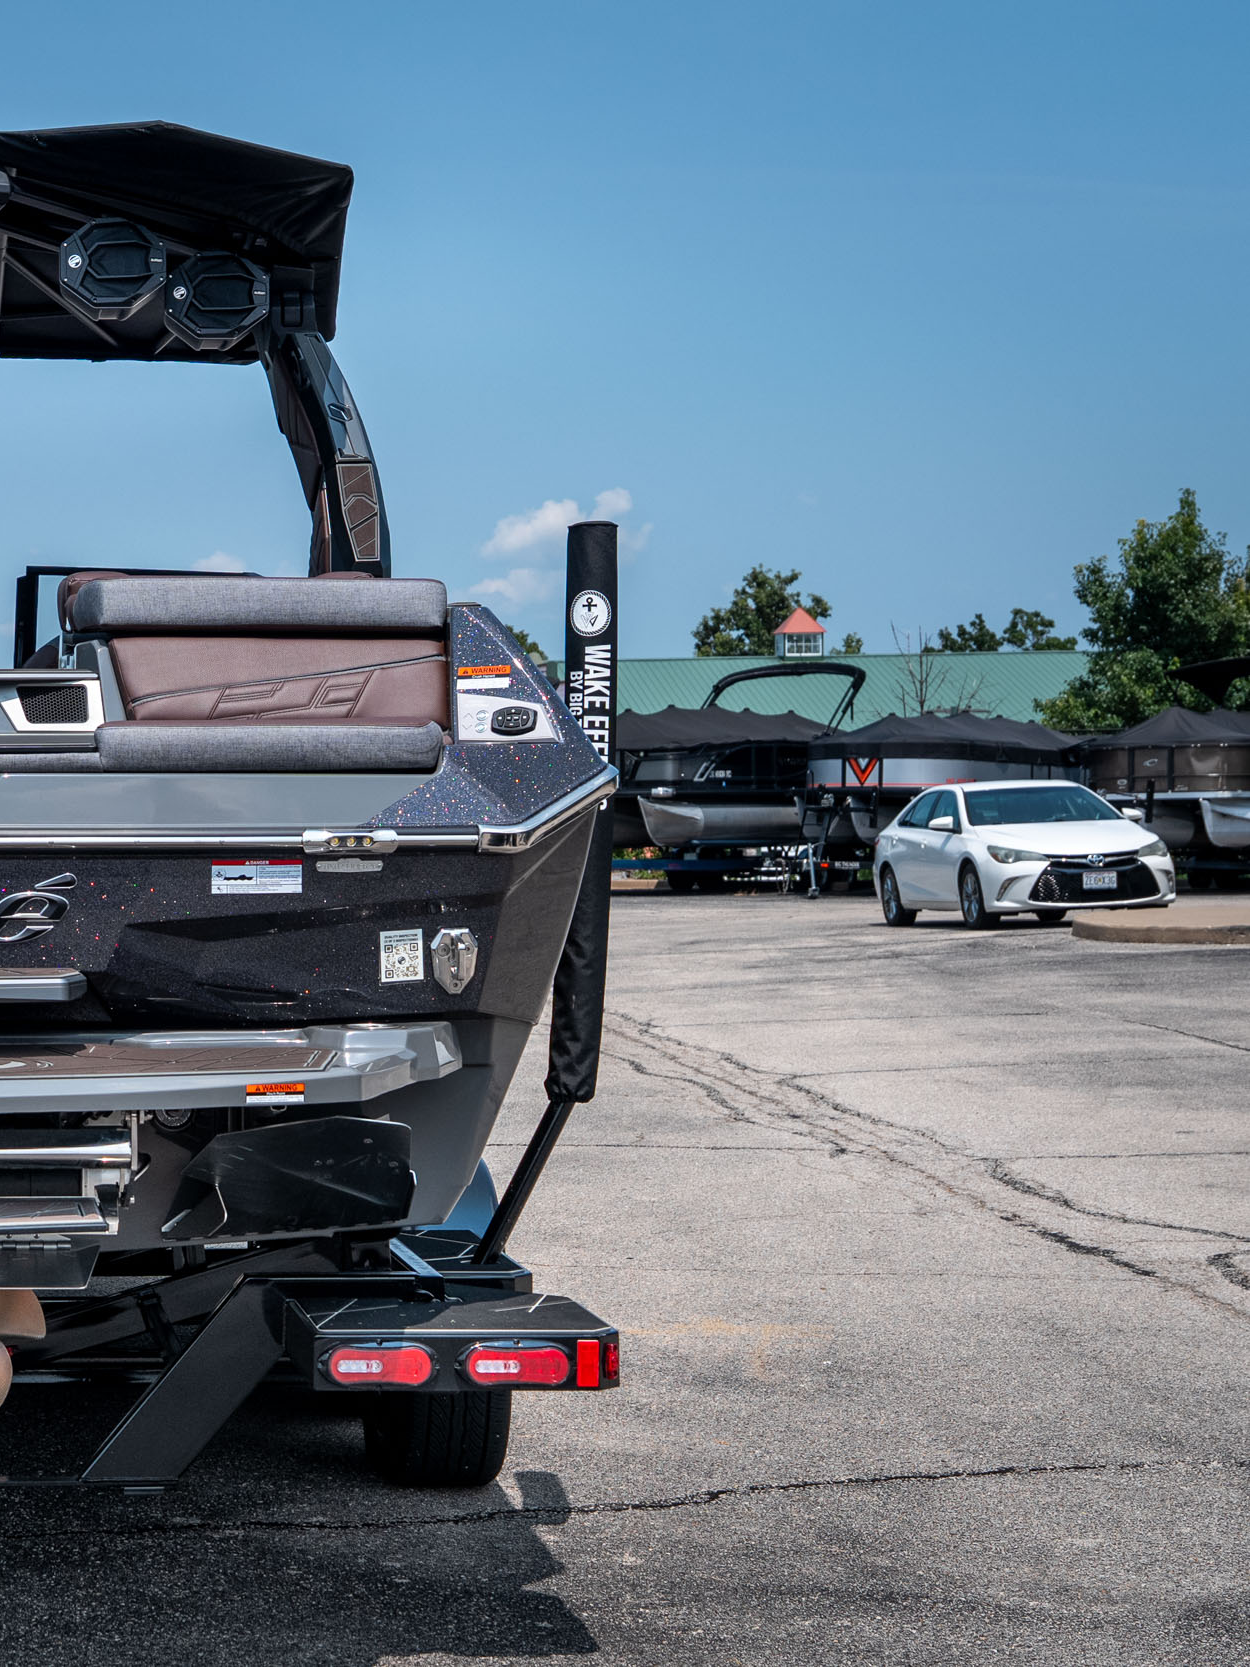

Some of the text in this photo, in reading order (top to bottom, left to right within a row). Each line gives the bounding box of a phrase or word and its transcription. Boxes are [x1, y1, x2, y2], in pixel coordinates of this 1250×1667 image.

[570, 671, 583, 689] BY
[583, 643, 611, 710] WAKE
[569, 693, 583, 716] BIG
